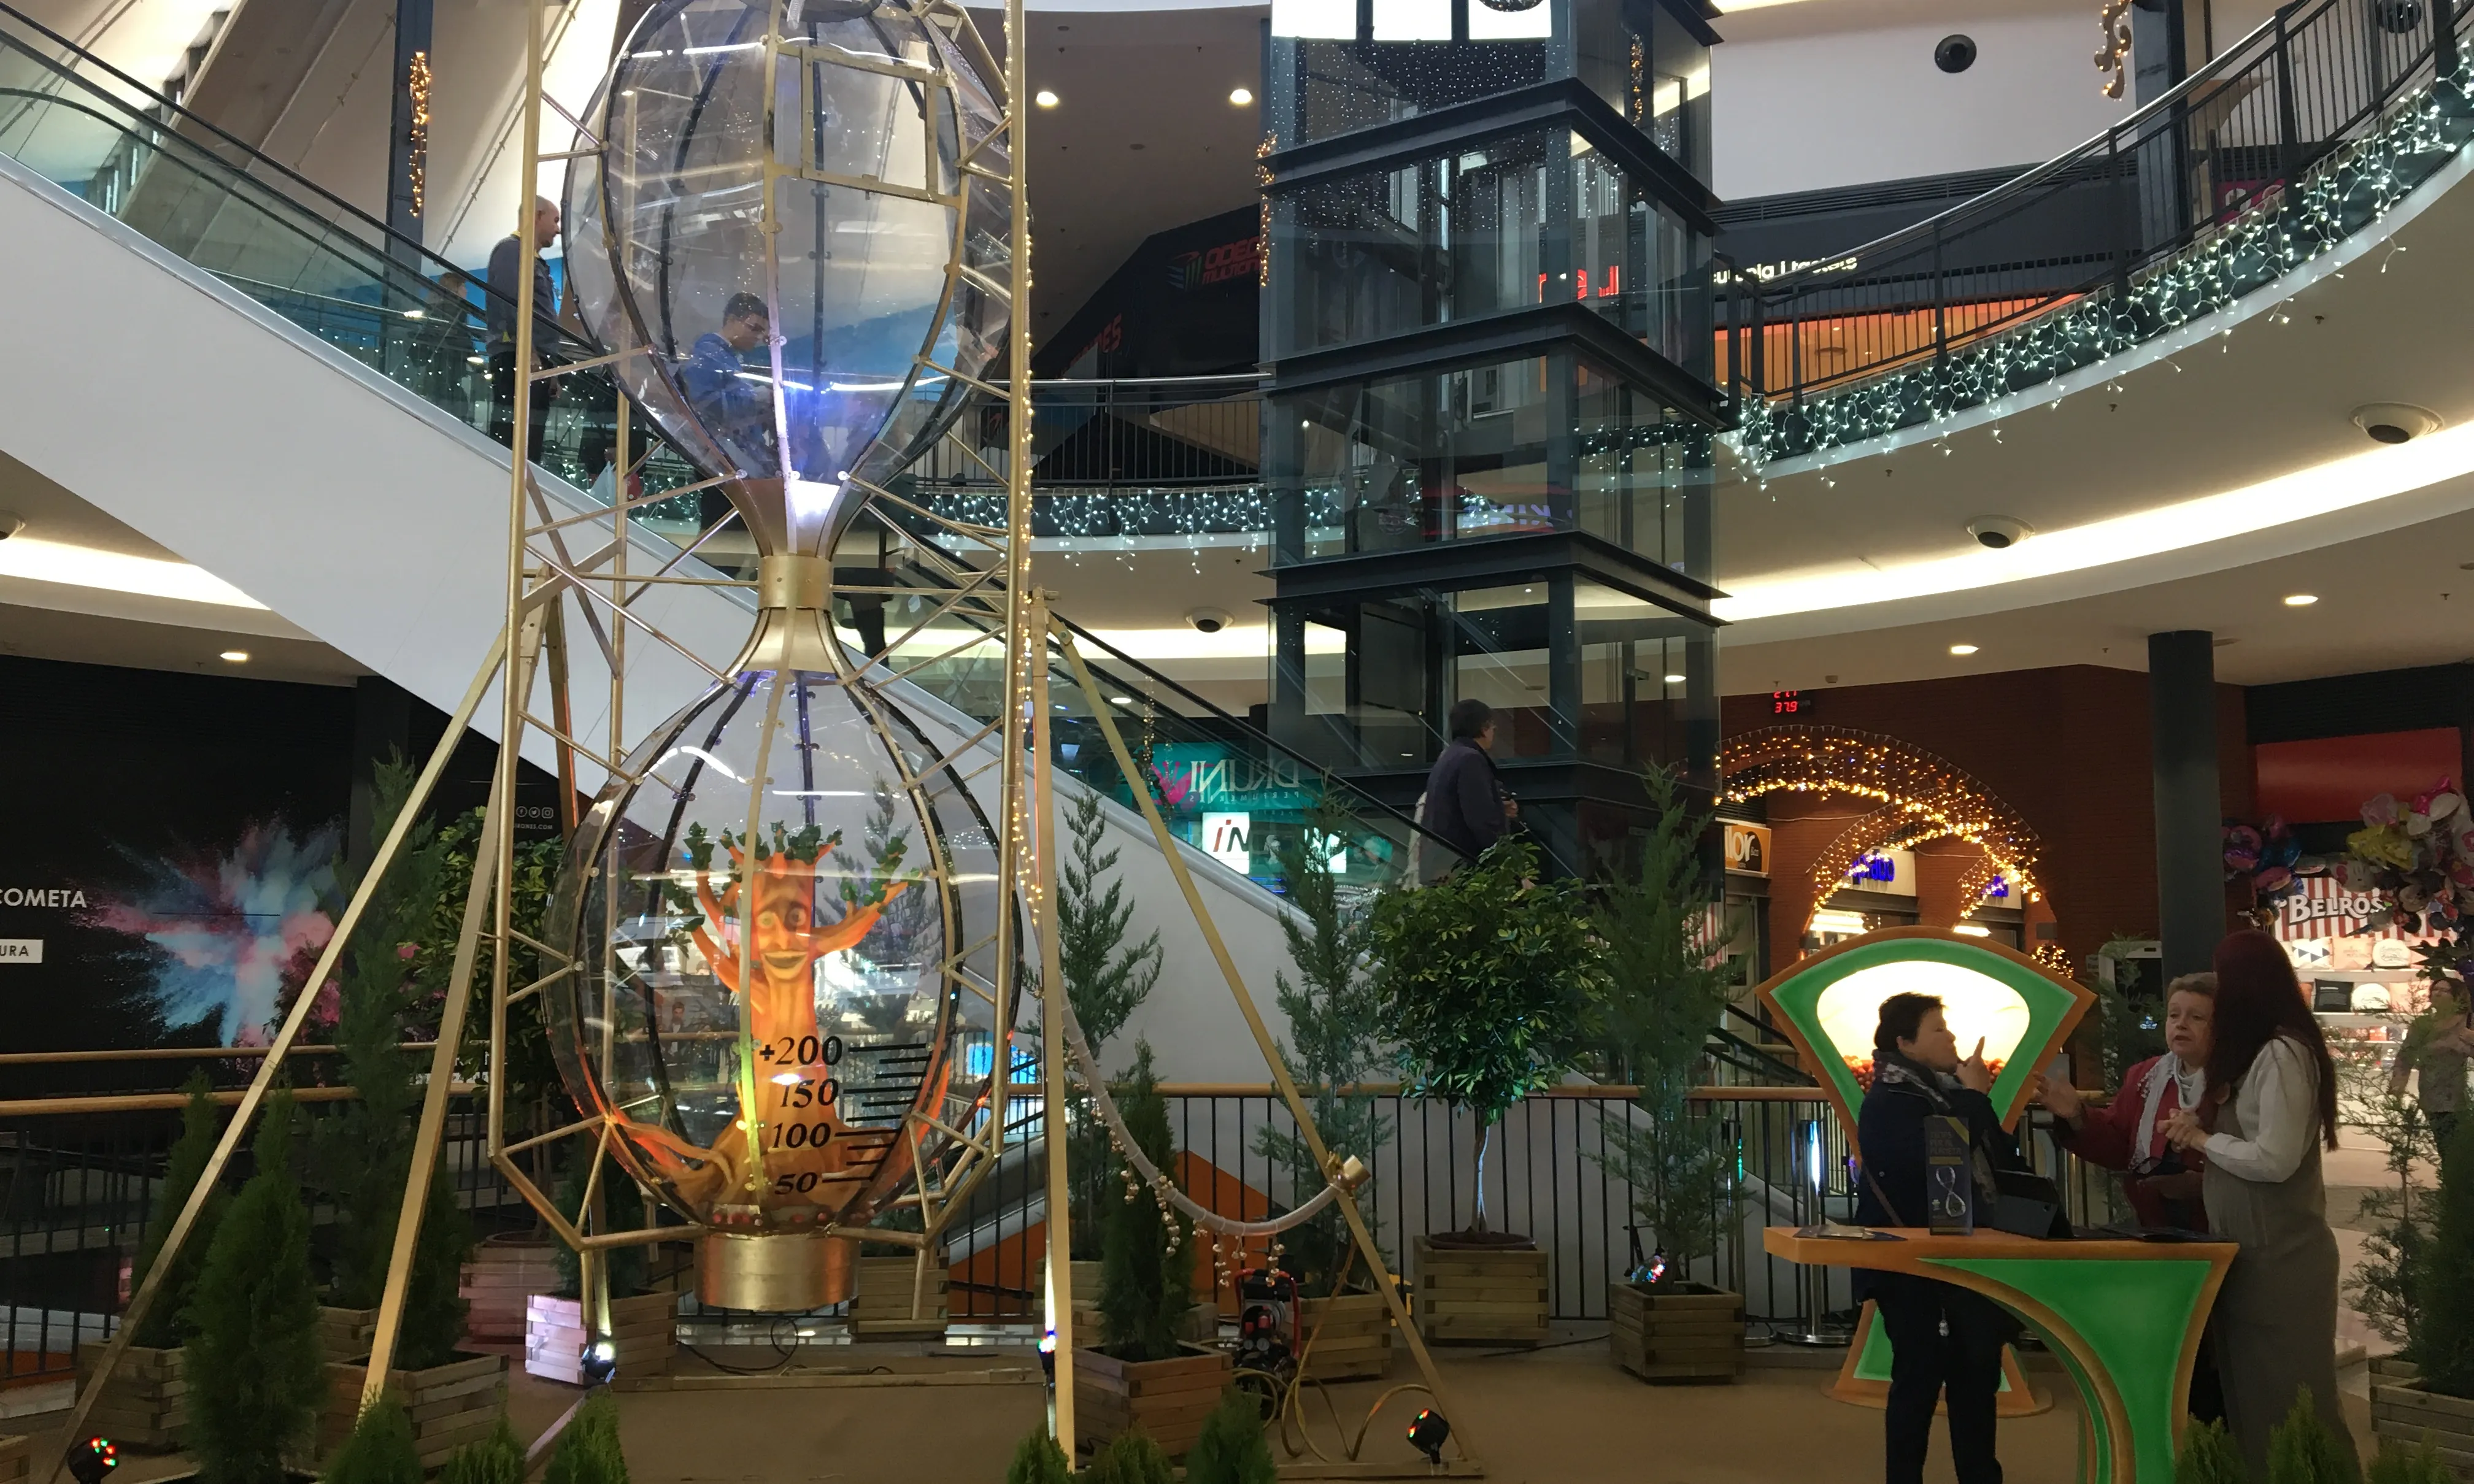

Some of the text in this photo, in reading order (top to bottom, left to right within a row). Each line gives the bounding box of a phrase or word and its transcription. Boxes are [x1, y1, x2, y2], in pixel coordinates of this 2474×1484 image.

[0, 888, 88, 908] OMETA
[2289, 894, 2386, 926] BELROS
[759, 1036, 843, 1066] +200
[780, 1078, 839, 1109] 150
[773, 1122, 831, 1148] 100
[774, 1171, 819, 1195] 50
